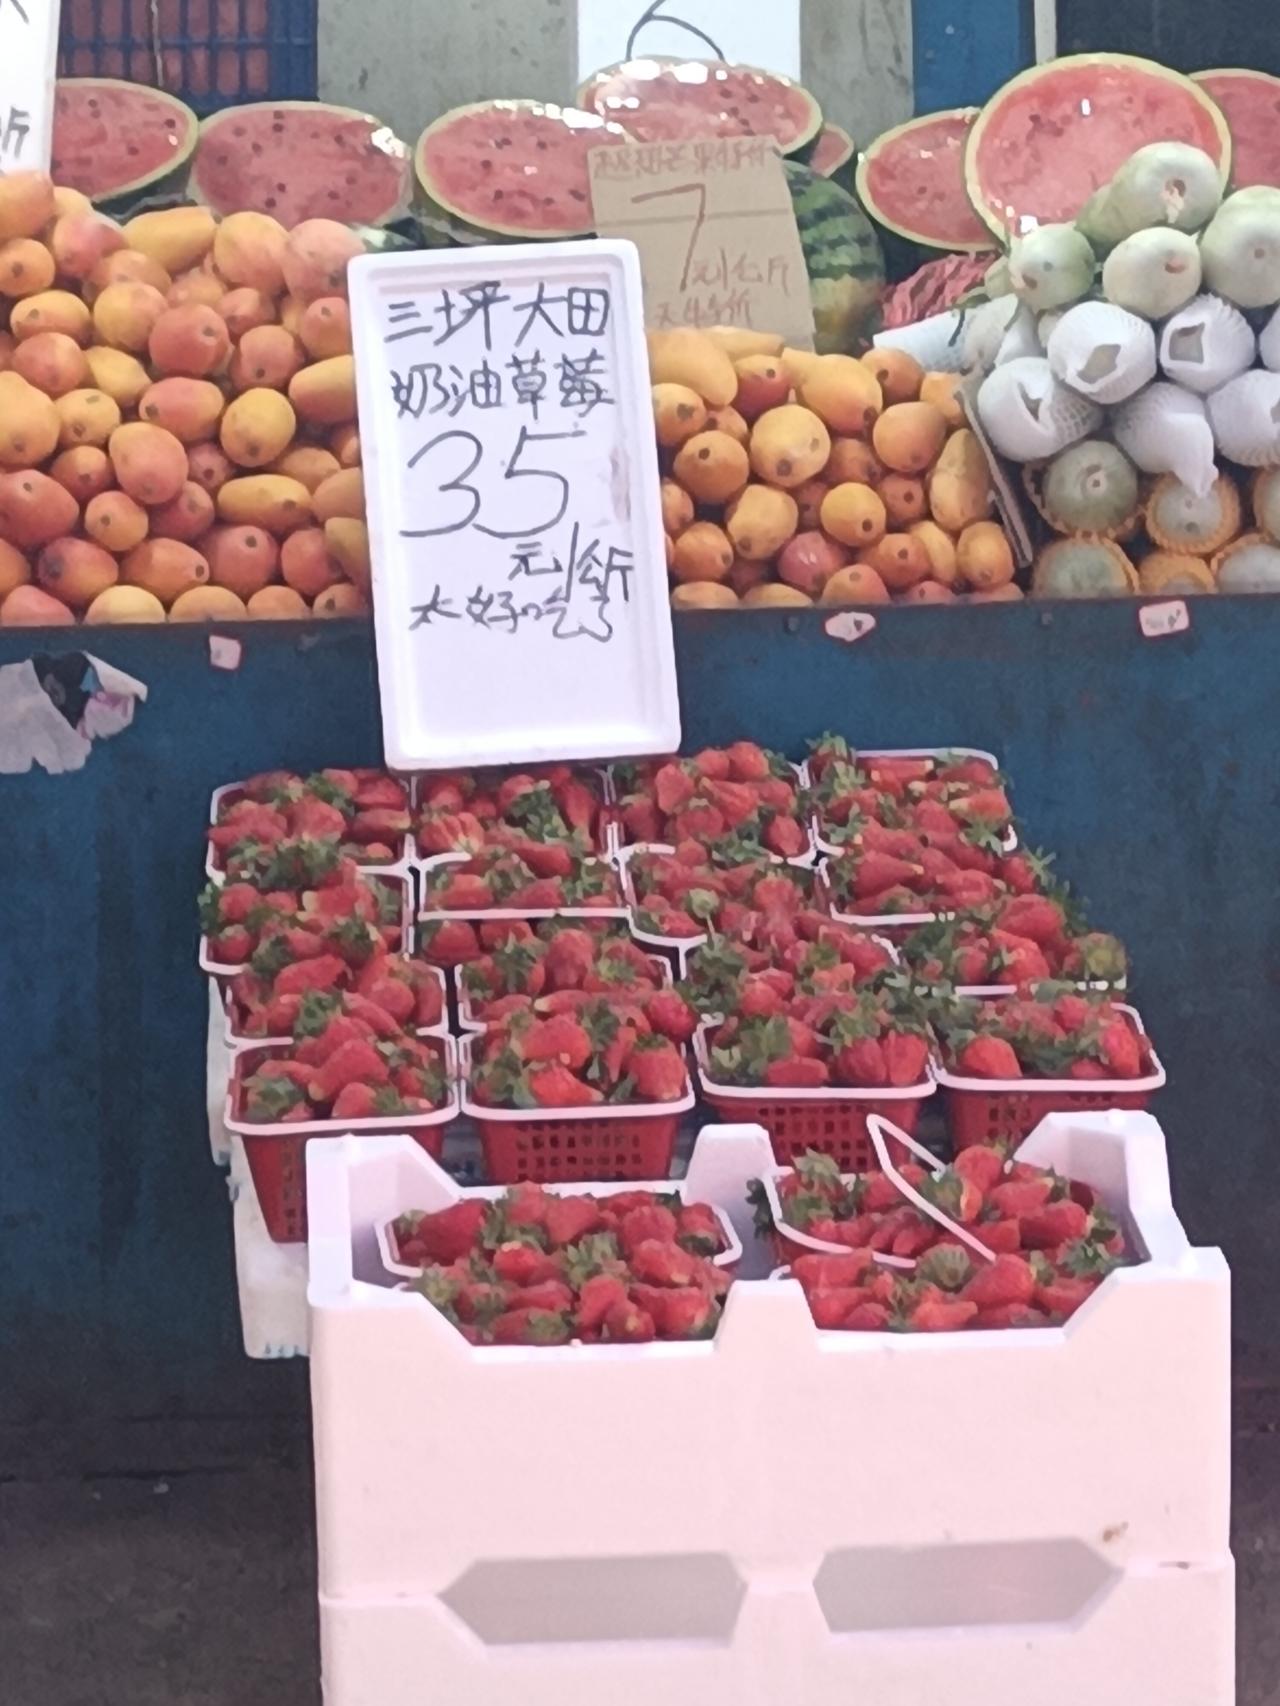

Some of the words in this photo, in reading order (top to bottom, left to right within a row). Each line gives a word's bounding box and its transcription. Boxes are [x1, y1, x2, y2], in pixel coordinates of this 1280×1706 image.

[631, 182, 706, 293] 7
[384, 280, 611, 351] 三坪大田
[390, 347, 616, 421] 奶油草莓
[400, 425, 587, 540] 35
